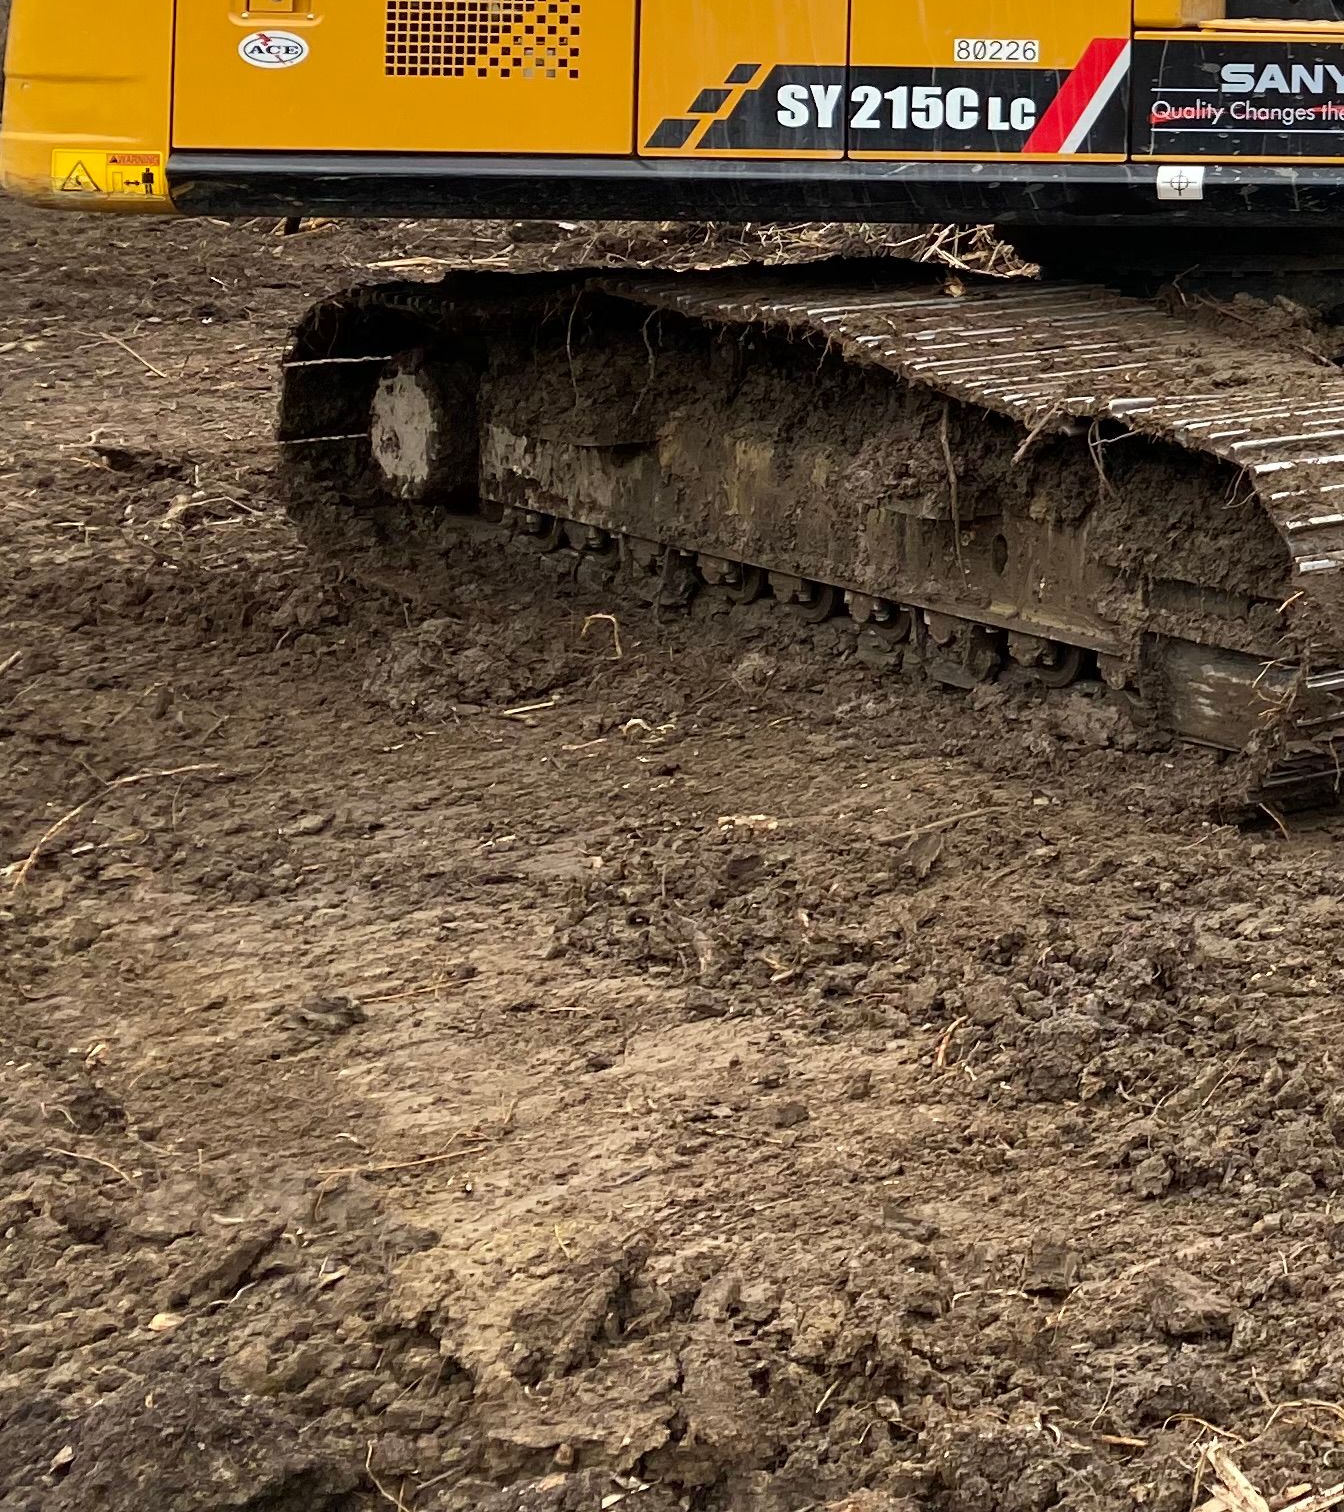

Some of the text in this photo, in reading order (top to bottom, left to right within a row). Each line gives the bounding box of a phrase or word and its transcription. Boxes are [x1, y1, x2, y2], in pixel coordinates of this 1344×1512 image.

[248, 45, 300, 55] ACE
[956, 39, 1037, 61] 80226
[987, 96, 1036, 131] LC
[1151, 99, 1225, 125] Quality
[1230, 101, 1316, 125] Changes
